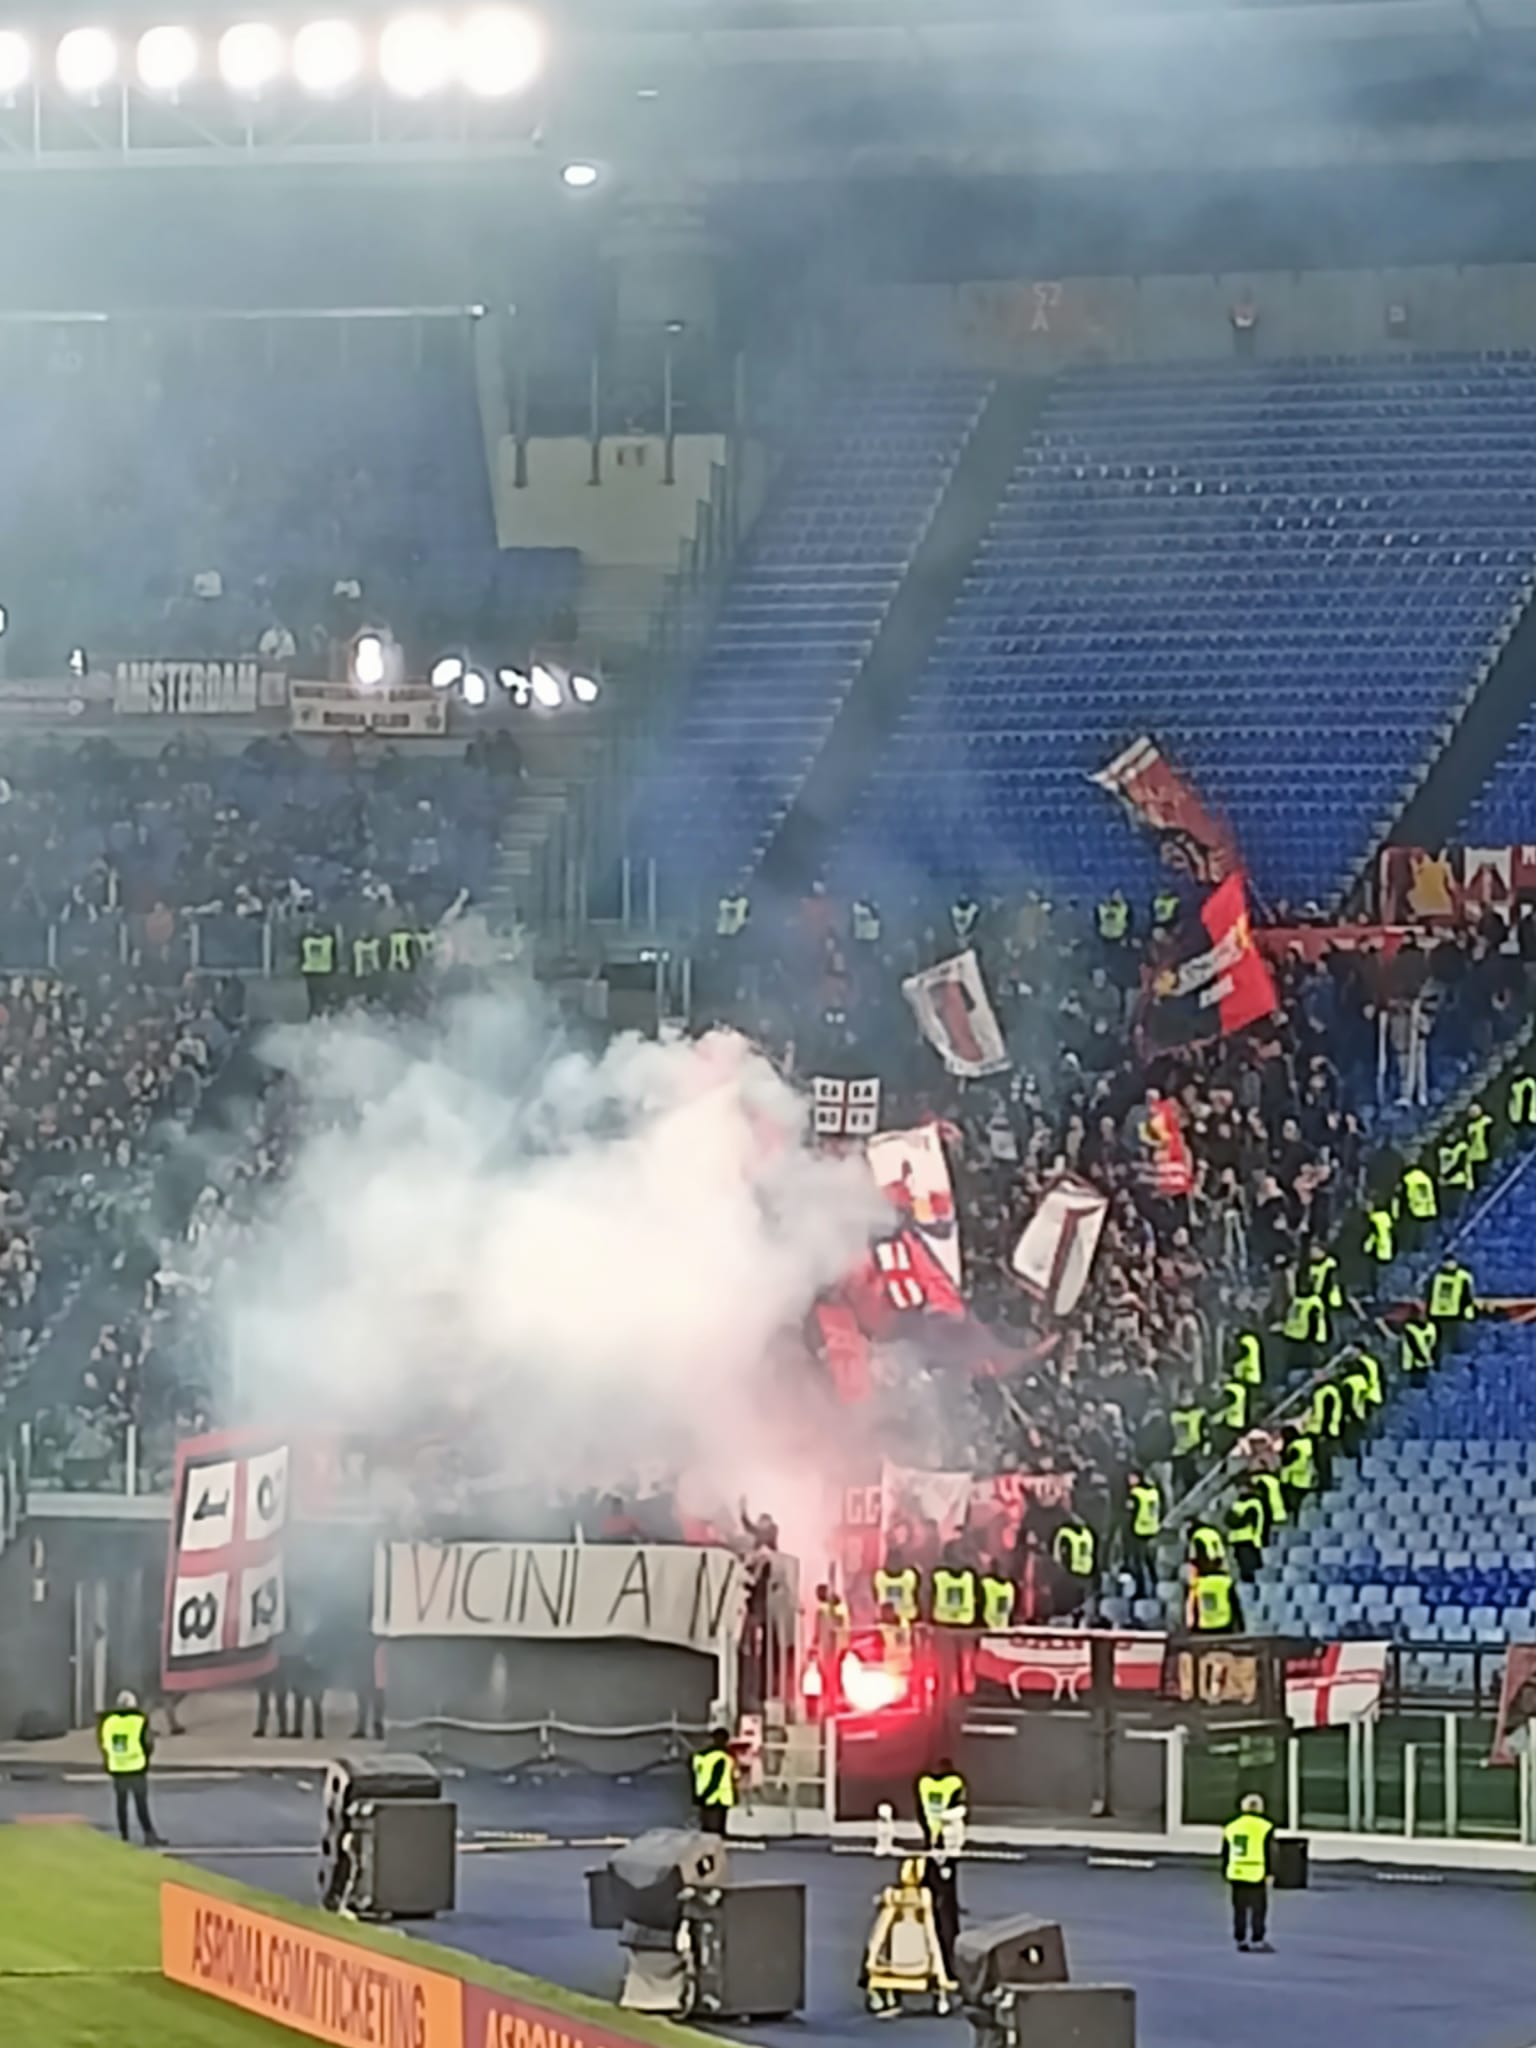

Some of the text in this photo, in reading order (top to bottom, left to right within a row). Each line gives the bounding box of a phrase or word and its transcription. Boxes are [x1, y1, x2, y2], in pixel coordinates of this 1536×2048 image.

[113, 661, 256, 714] AMSTERDAM
[410, 1545, 581, 1628] VICINI
[607, 1549, 652, 1629] A
[191, 1908, 427, 2048] ASROMA.COM/TICKETING
